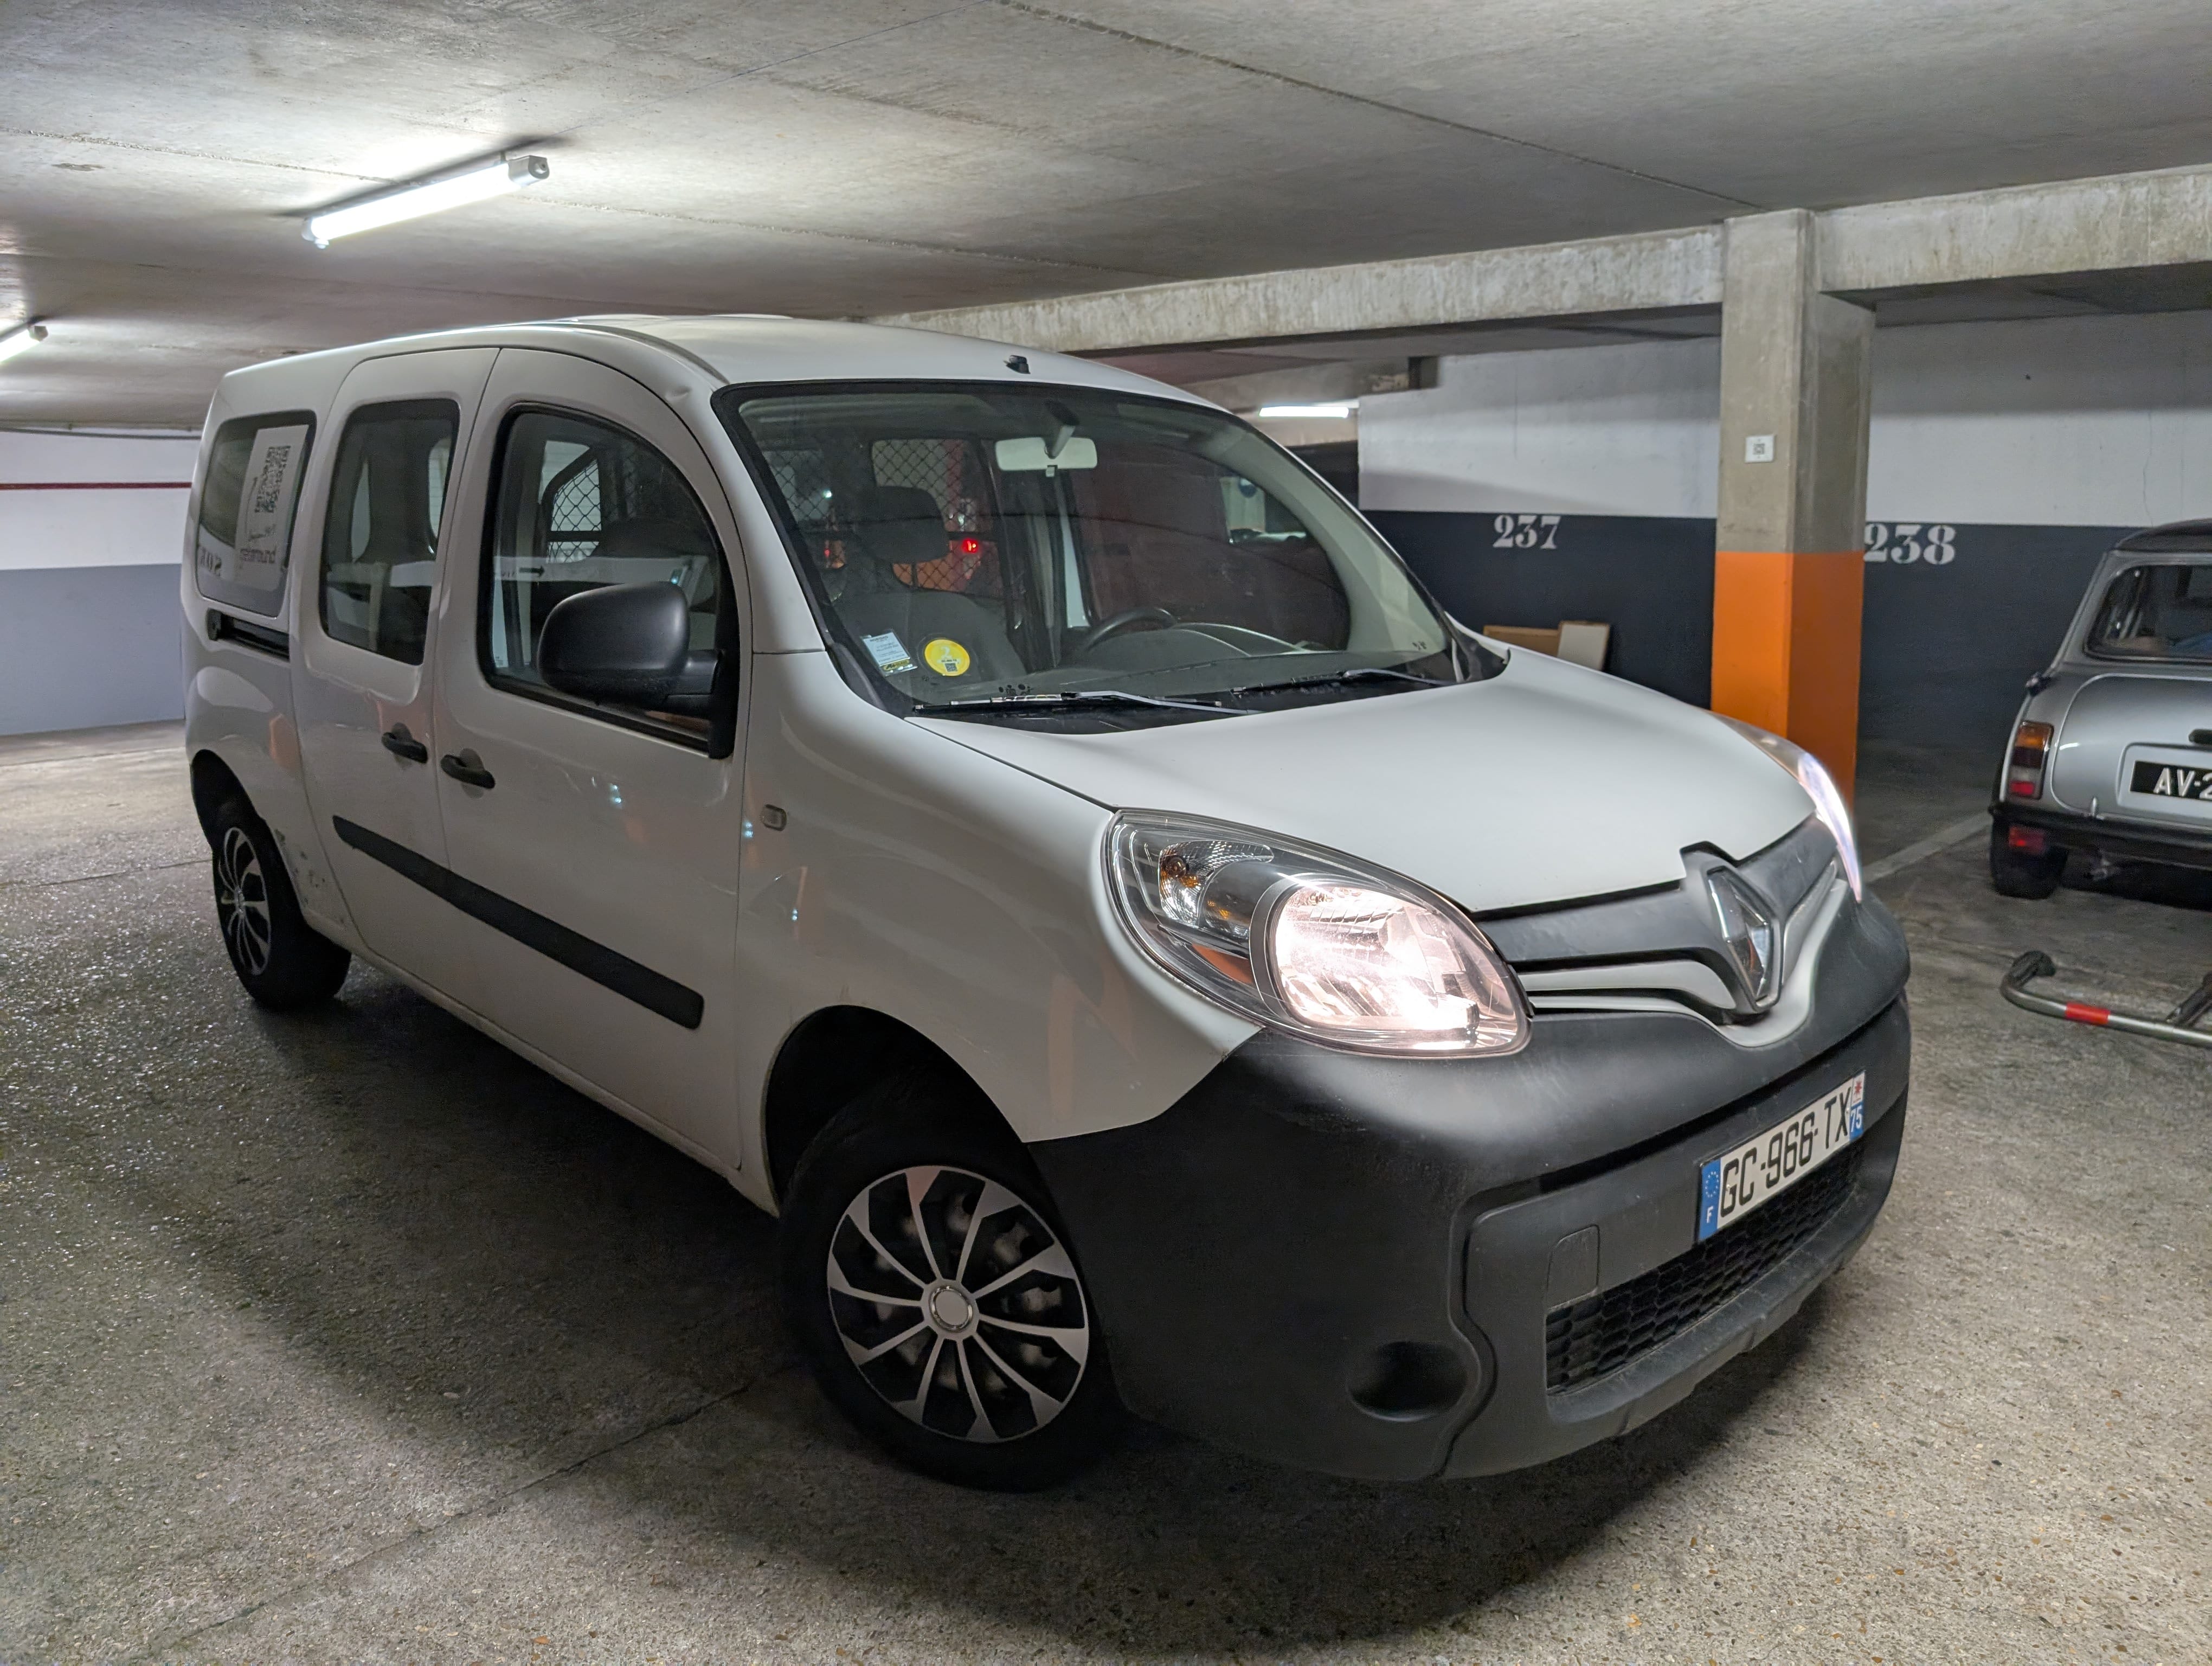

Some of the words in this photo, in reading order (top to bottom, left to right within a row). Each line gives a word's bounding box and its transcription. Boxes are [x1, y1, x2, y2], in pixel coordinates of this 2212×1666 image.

[1493, 515, 1561, 549] 237
[1863, 523, 1956, 565] 238
[1850, 1106, 1862, 1133] 75
[1706, 1206, 1714, 1224] F
